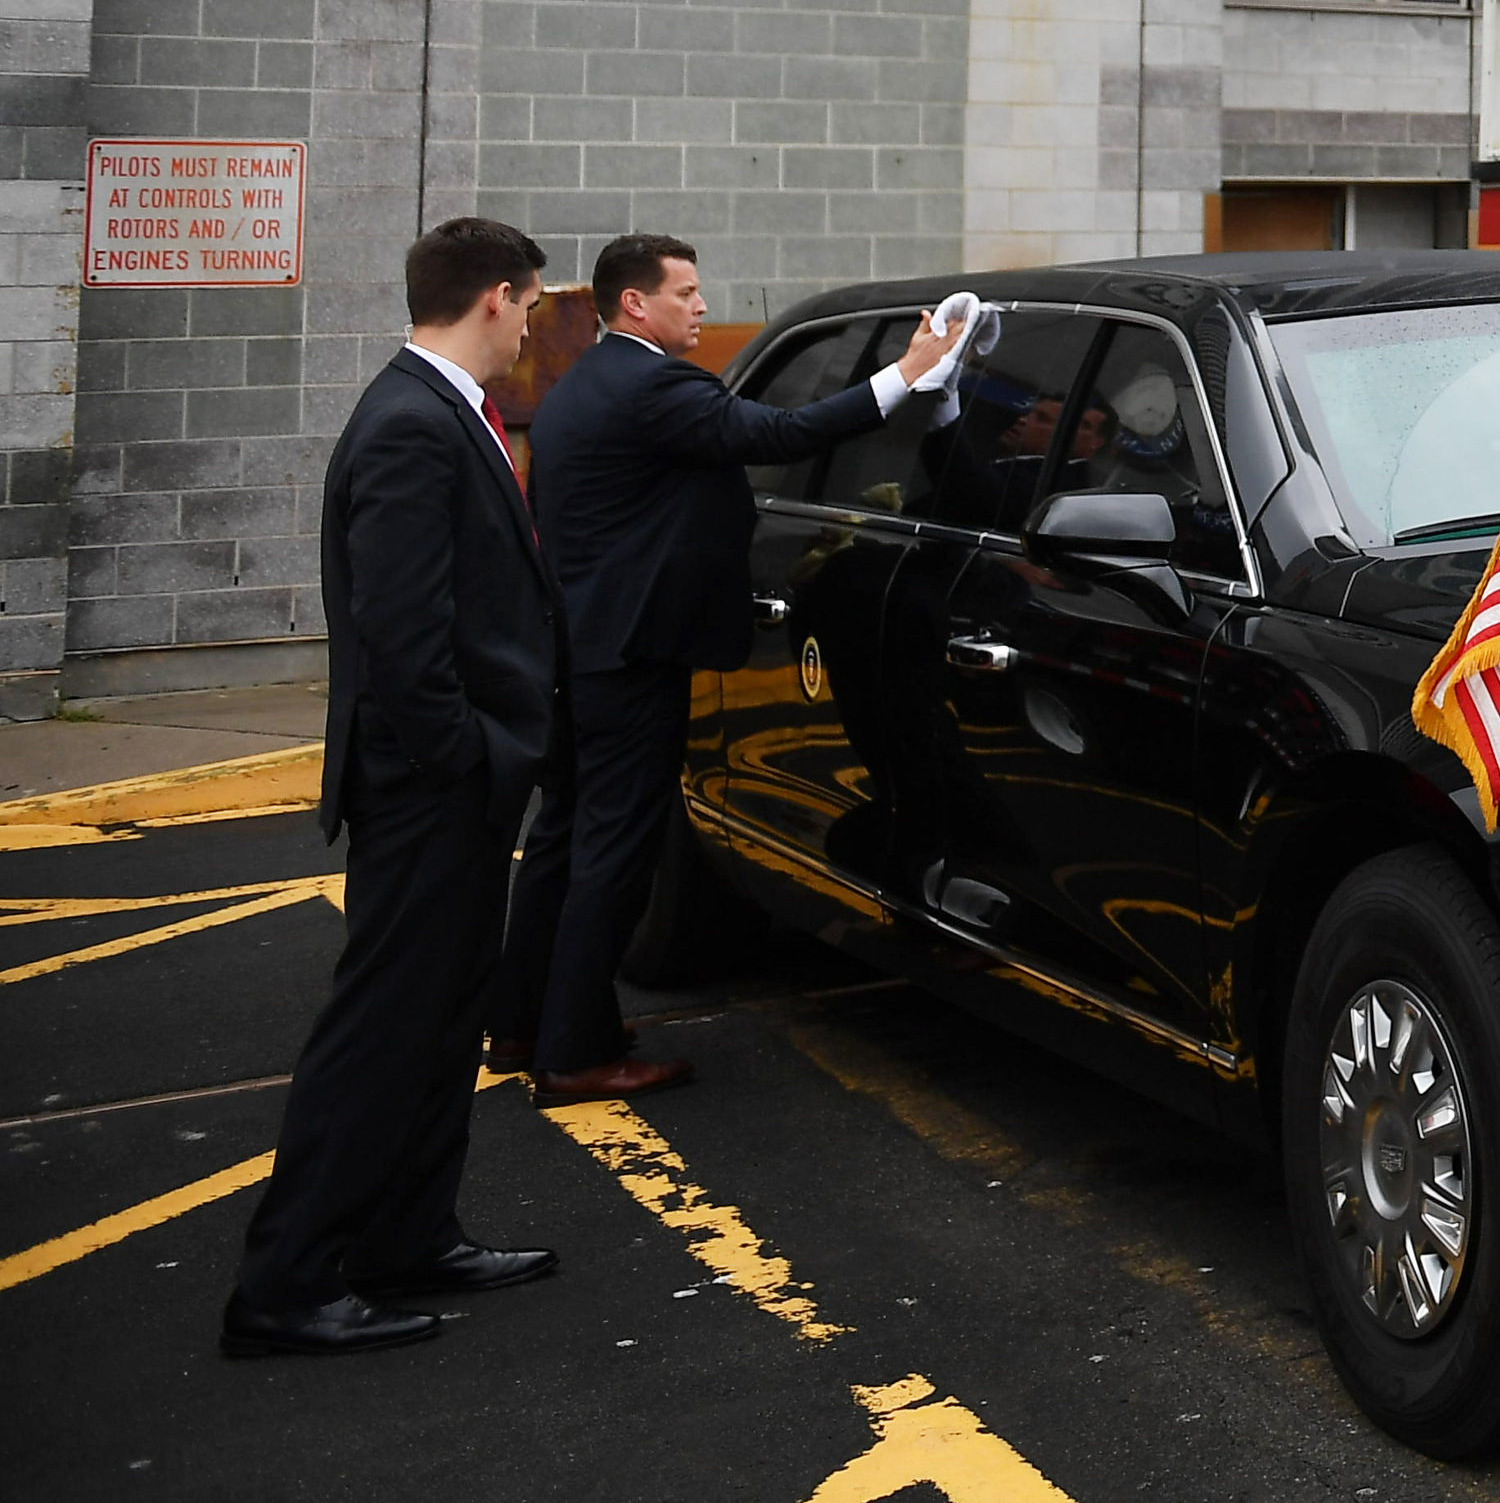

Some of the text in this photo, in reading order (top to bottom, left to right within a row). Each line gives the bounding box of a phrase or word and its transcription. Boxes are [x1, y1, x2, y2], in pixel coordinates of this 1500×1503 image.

[100, 156, 293, 178] PILOTS MUST REMAIN
[109, 188, 283, 209] AT CONTROLS WITH
[107, 218, 179, 239] ROTORS
[188, 219, 225, 238] AND
[252, 219, 280, 238] OR
[93, 250, 291, 270] ENGINES TURNING
